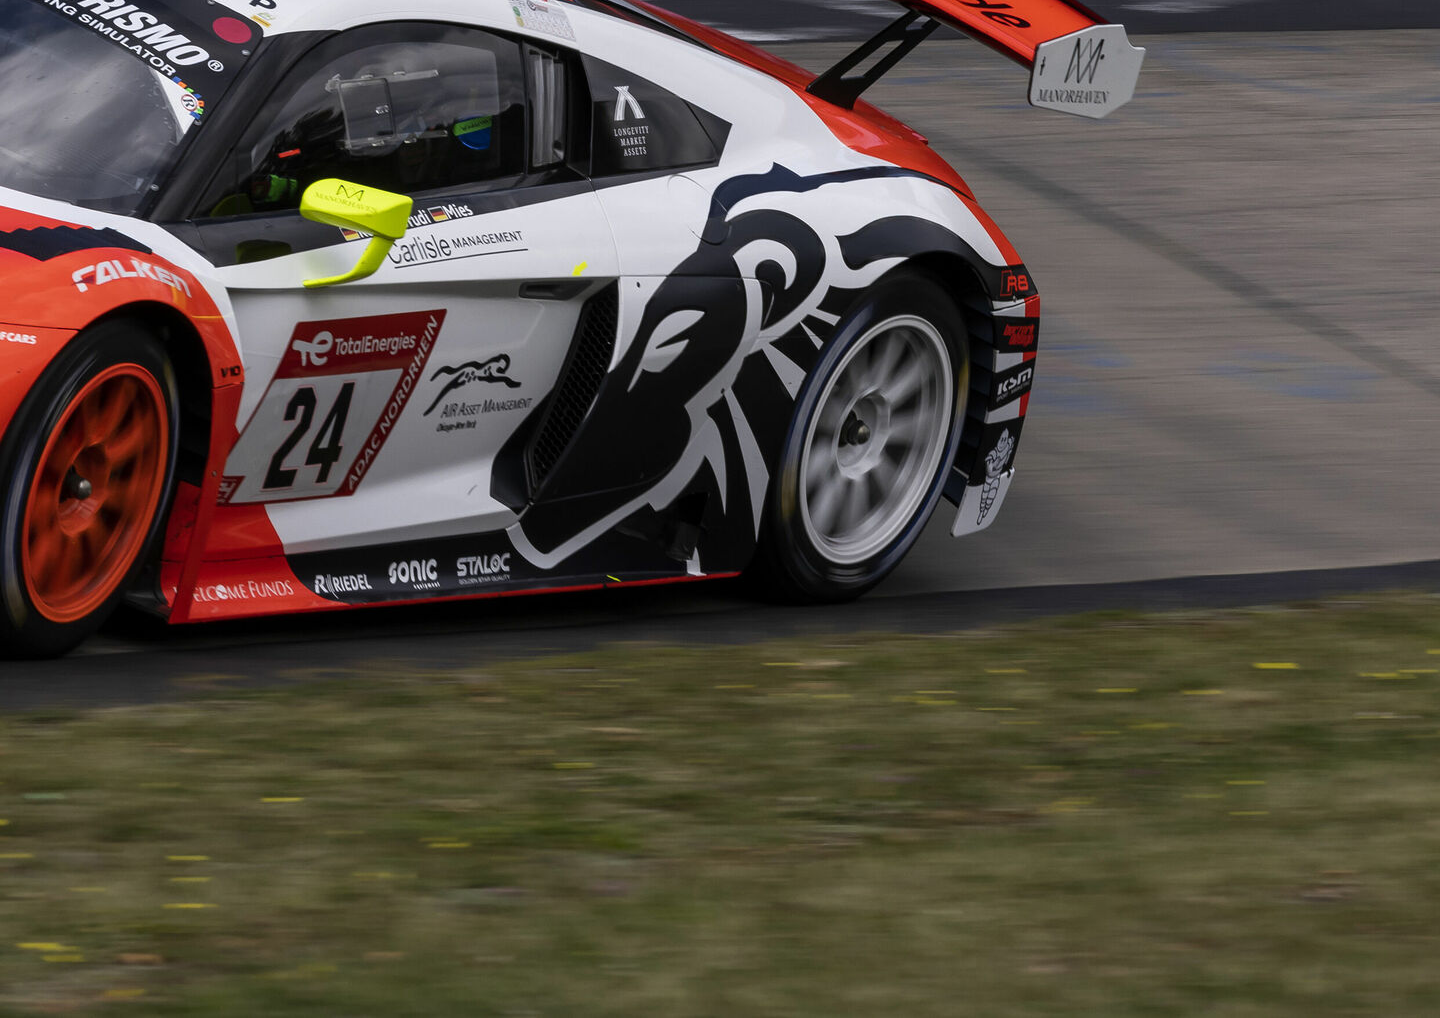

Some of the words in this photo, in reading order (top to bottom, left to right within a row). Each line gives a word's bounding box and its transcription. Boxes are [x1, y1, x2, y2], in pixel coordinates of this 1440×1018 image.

[78, 13, 176, 77] SIMULATOR
[1037, 89, 1109, 103] MANORHAVEN
[614, 126, 648, 136] LONGEVITY
[620, 136, 646, 146] MARKET
[624, 147, 647, 156] ASSETS
[406, 210, 431, 227] rudi
[445, 204, 474, 221] Mies
[452, 231, 523, 249] MANAGEMENT
[1007, 275, 1029, 292] R8
[335, 332, 417, 355] TotalEnergies
[348, 434, 382, 490] ADAC
[380, 315, 439, 434] NORDRHEIN
[262, 382, 355, 490] 24
[456, 552, 510, 577] STALOC
[248, 580, 294, 599] FUNDS
[333, 573, 372, 592] RIEDEL
